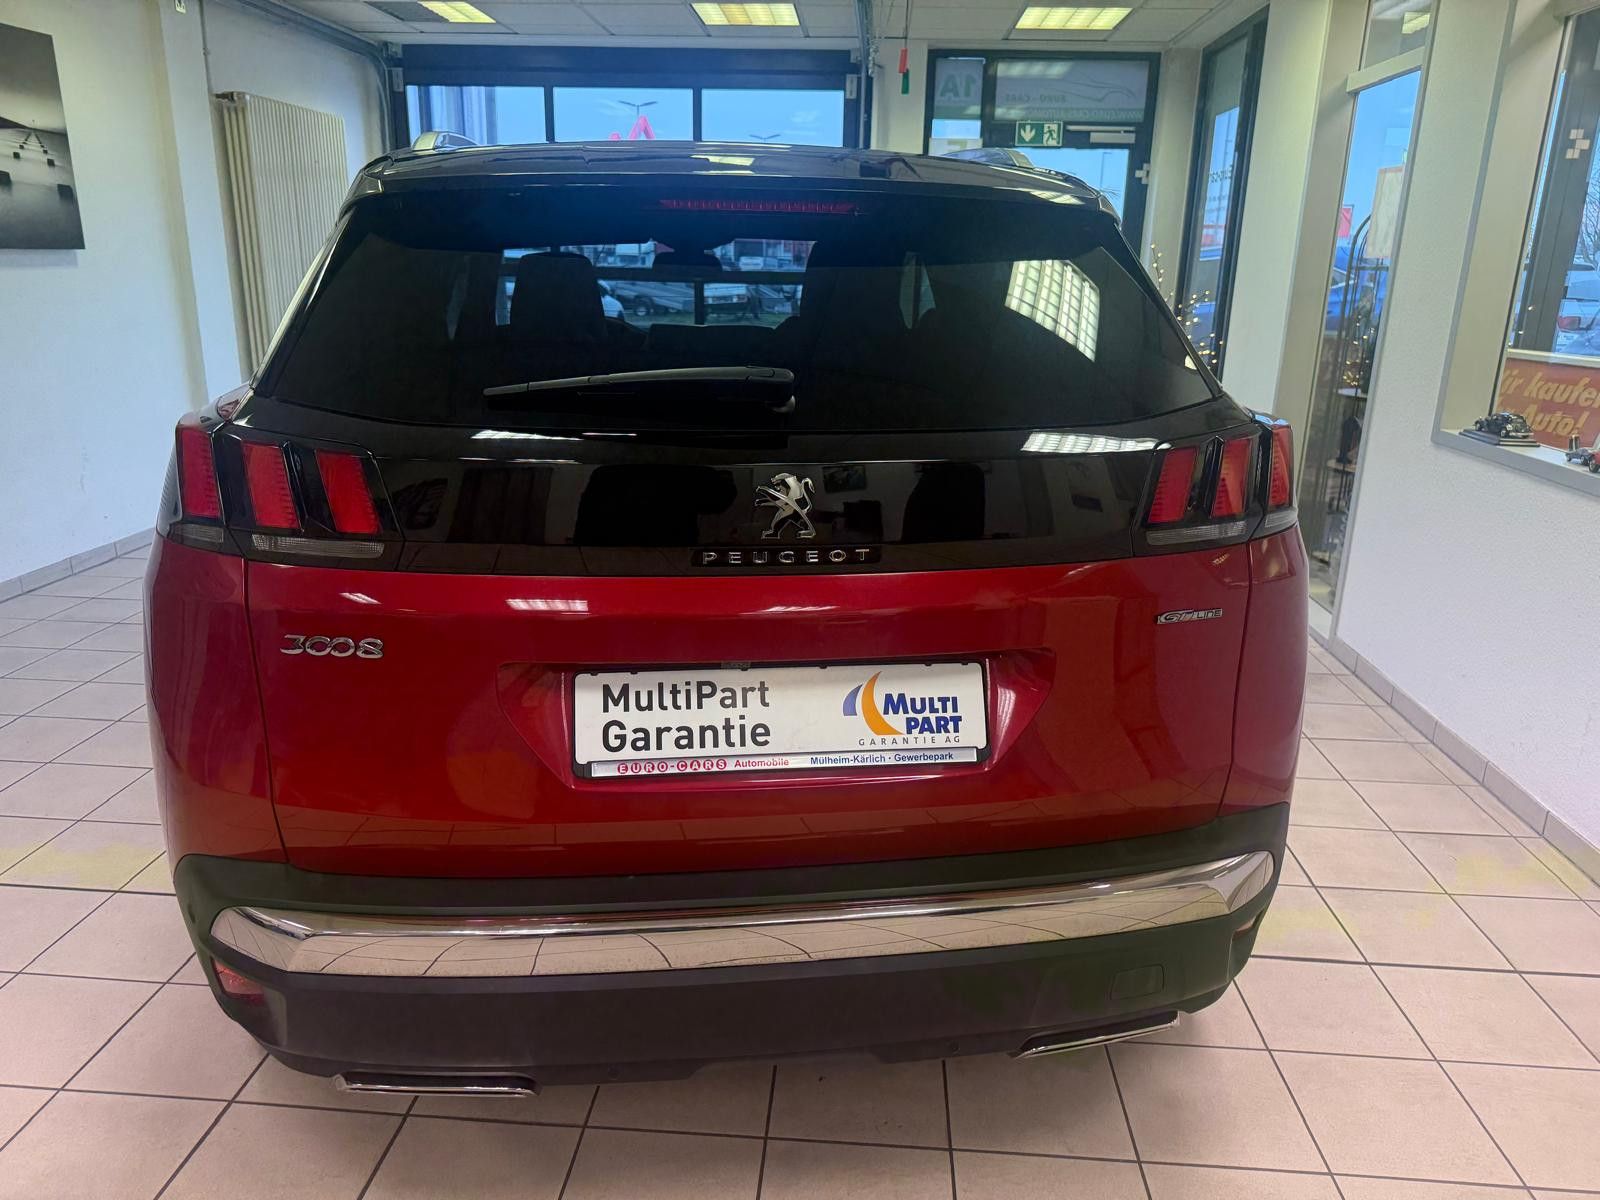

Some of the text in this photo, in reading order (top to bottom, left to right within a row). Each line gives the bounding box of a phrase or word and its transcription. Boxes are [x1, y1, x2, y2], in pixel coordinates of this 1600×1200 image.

[702, 548, 870, 565] PEUGEOT
[280, 634, 384, 659] 3008
[602, 680, 770, 713] MultiPart
[602, 715, 771, 753] Garantie
[905, 715, 963, 735] PART
[858, 735, 961, 746] GARANTIE AG
[617, 752, 954, 775] EURO-CARS Automobile Mülheim-Kärlich Gewerbepark
